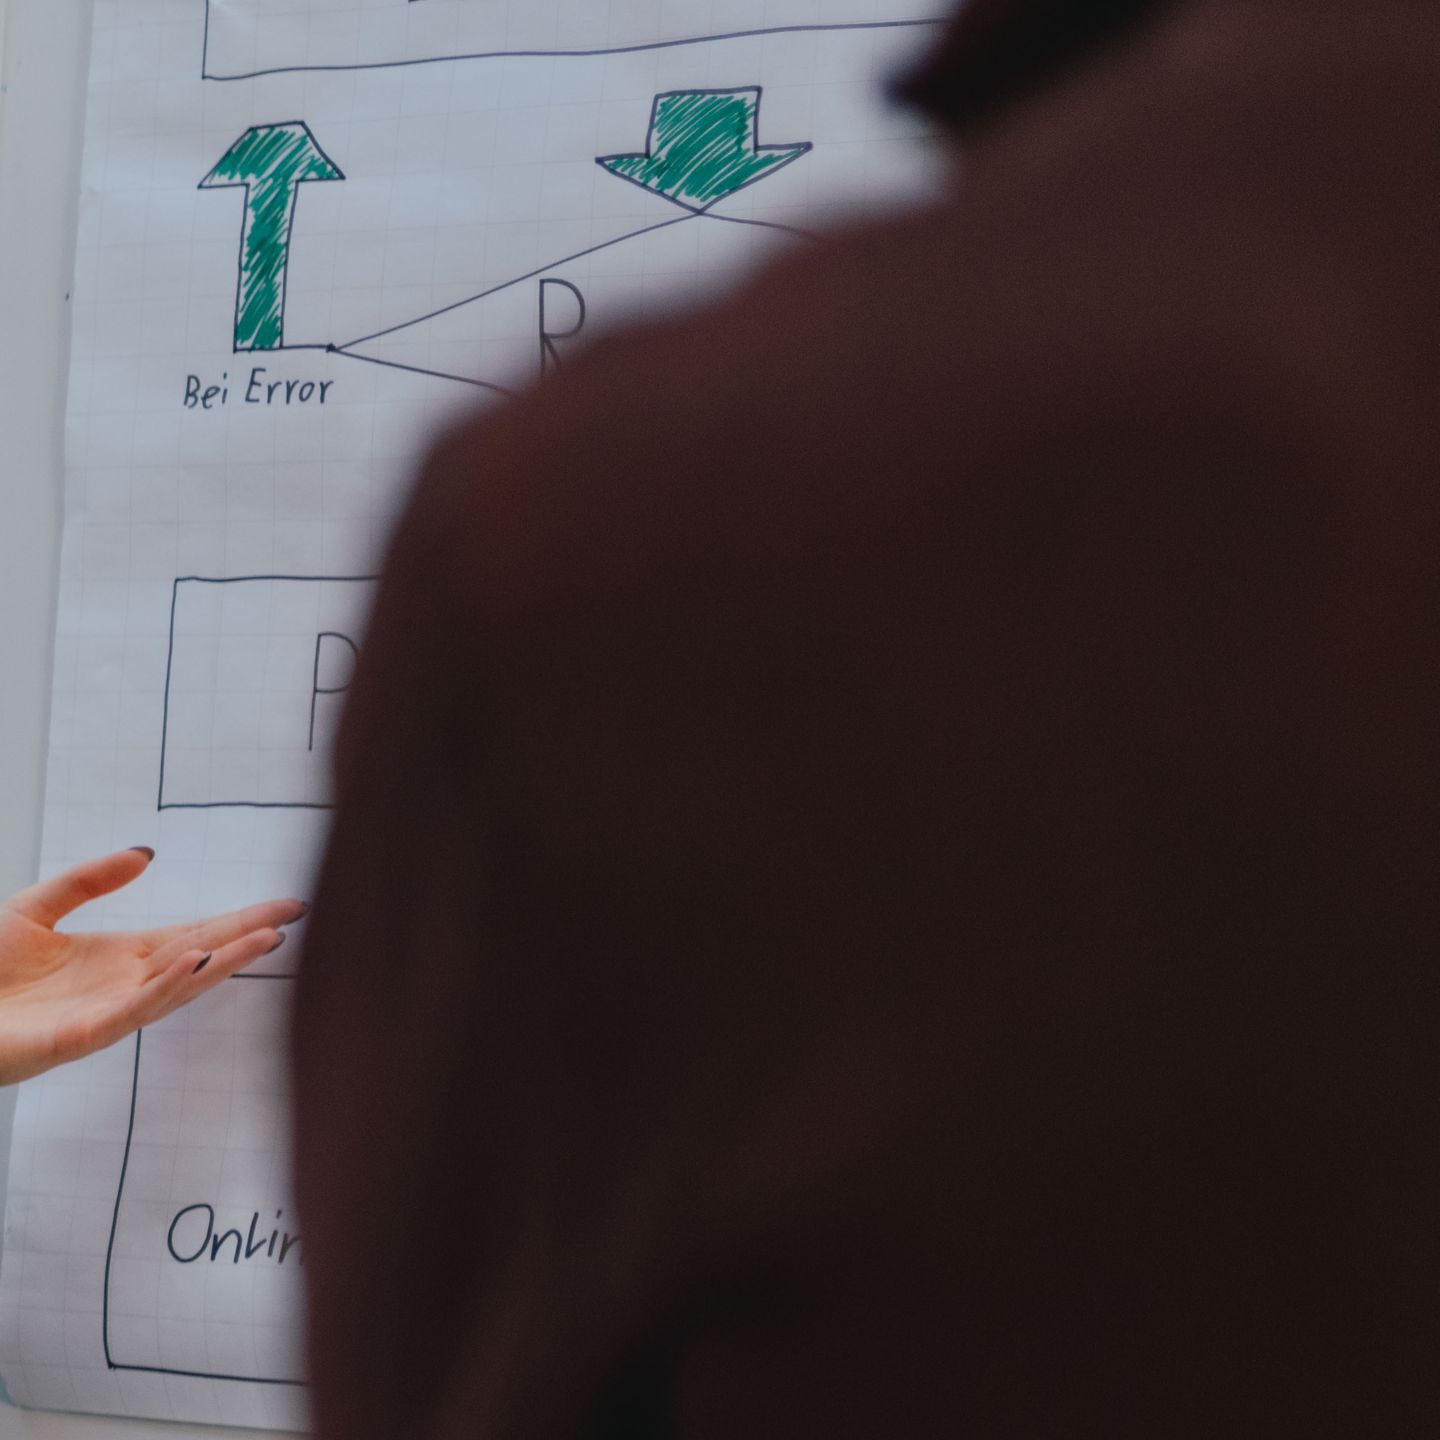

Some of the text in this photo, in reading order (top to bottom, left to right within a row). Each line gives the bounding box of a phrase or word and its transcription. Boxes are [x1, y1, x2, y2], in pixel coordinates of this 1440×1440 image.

[182, 366, 335, 410] Bei Error
[166, 1203, 302, 1265] Onlin
